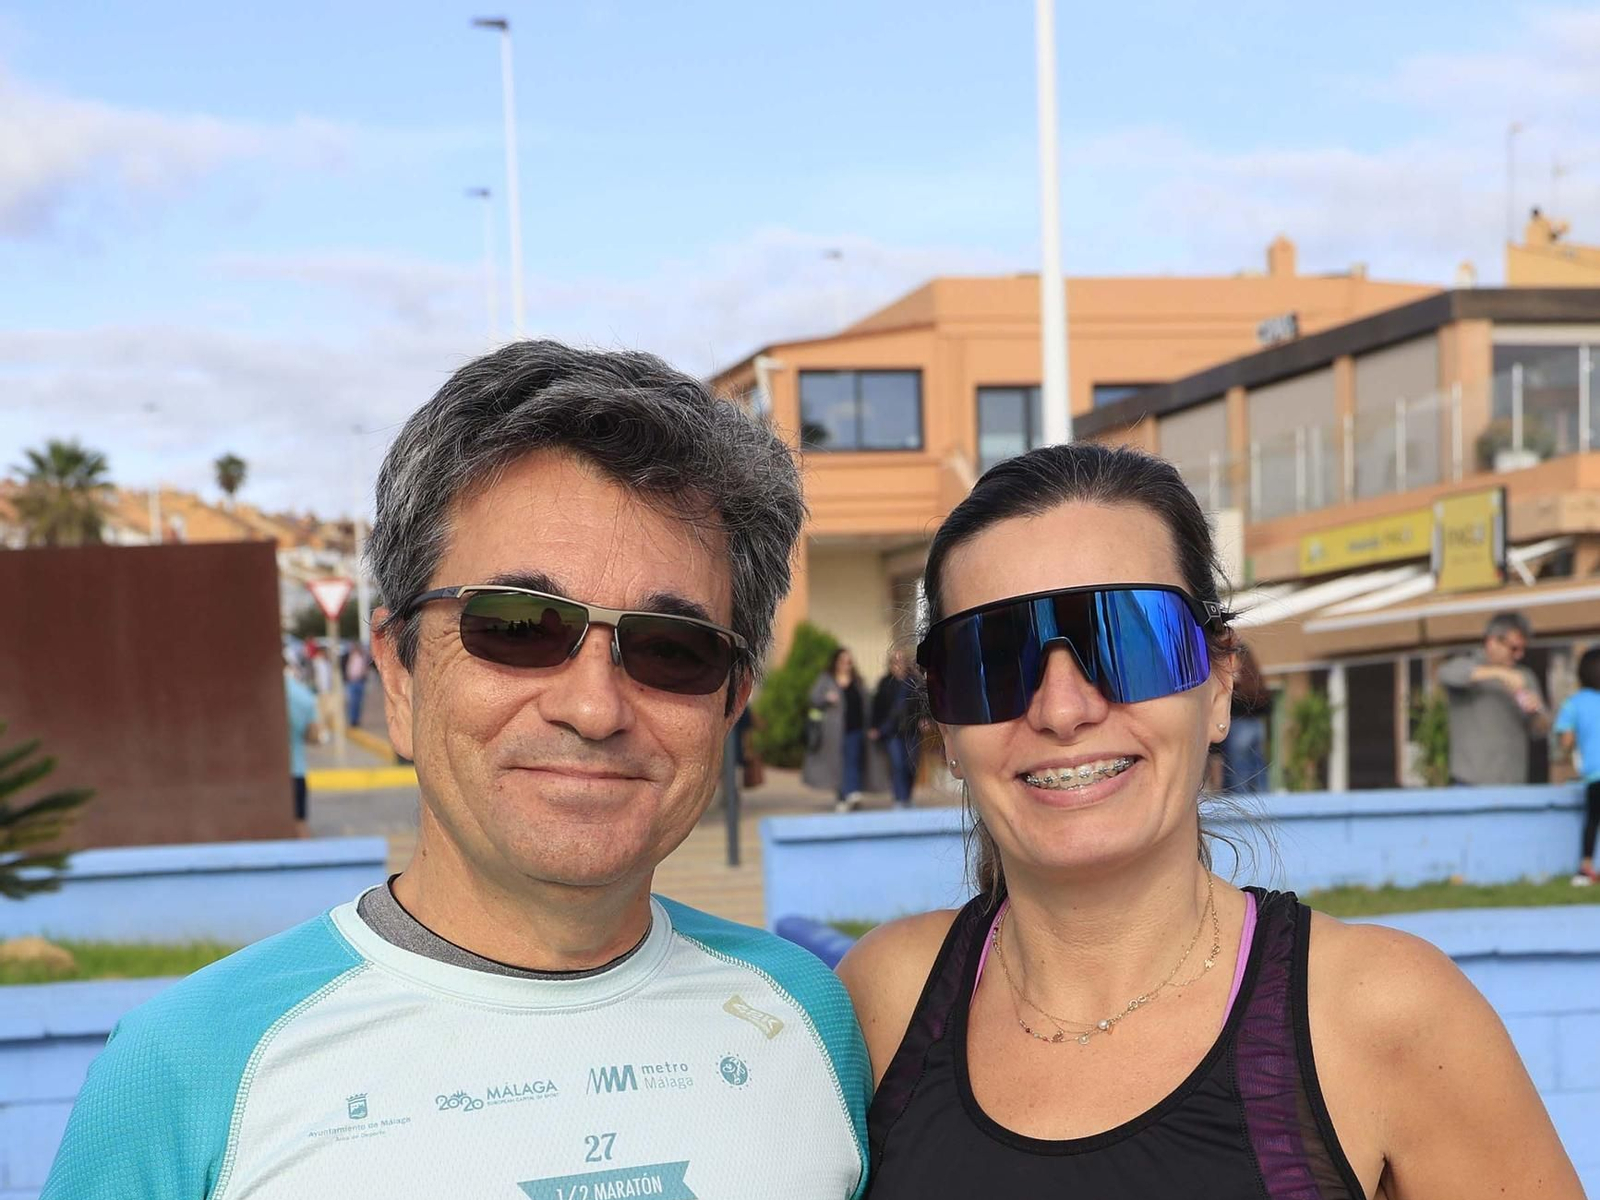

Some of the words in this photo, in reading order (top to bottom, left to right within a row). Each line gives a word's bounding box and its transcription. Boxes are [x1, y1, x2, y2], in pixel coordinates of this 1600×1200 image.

[641, 1061, 689, 1075] metro
[486, 1079, 558, 1100] MÁLAGA
[644, 1075, 694, 1091] Málaga
[584, 1132, 617, 1163] 27
